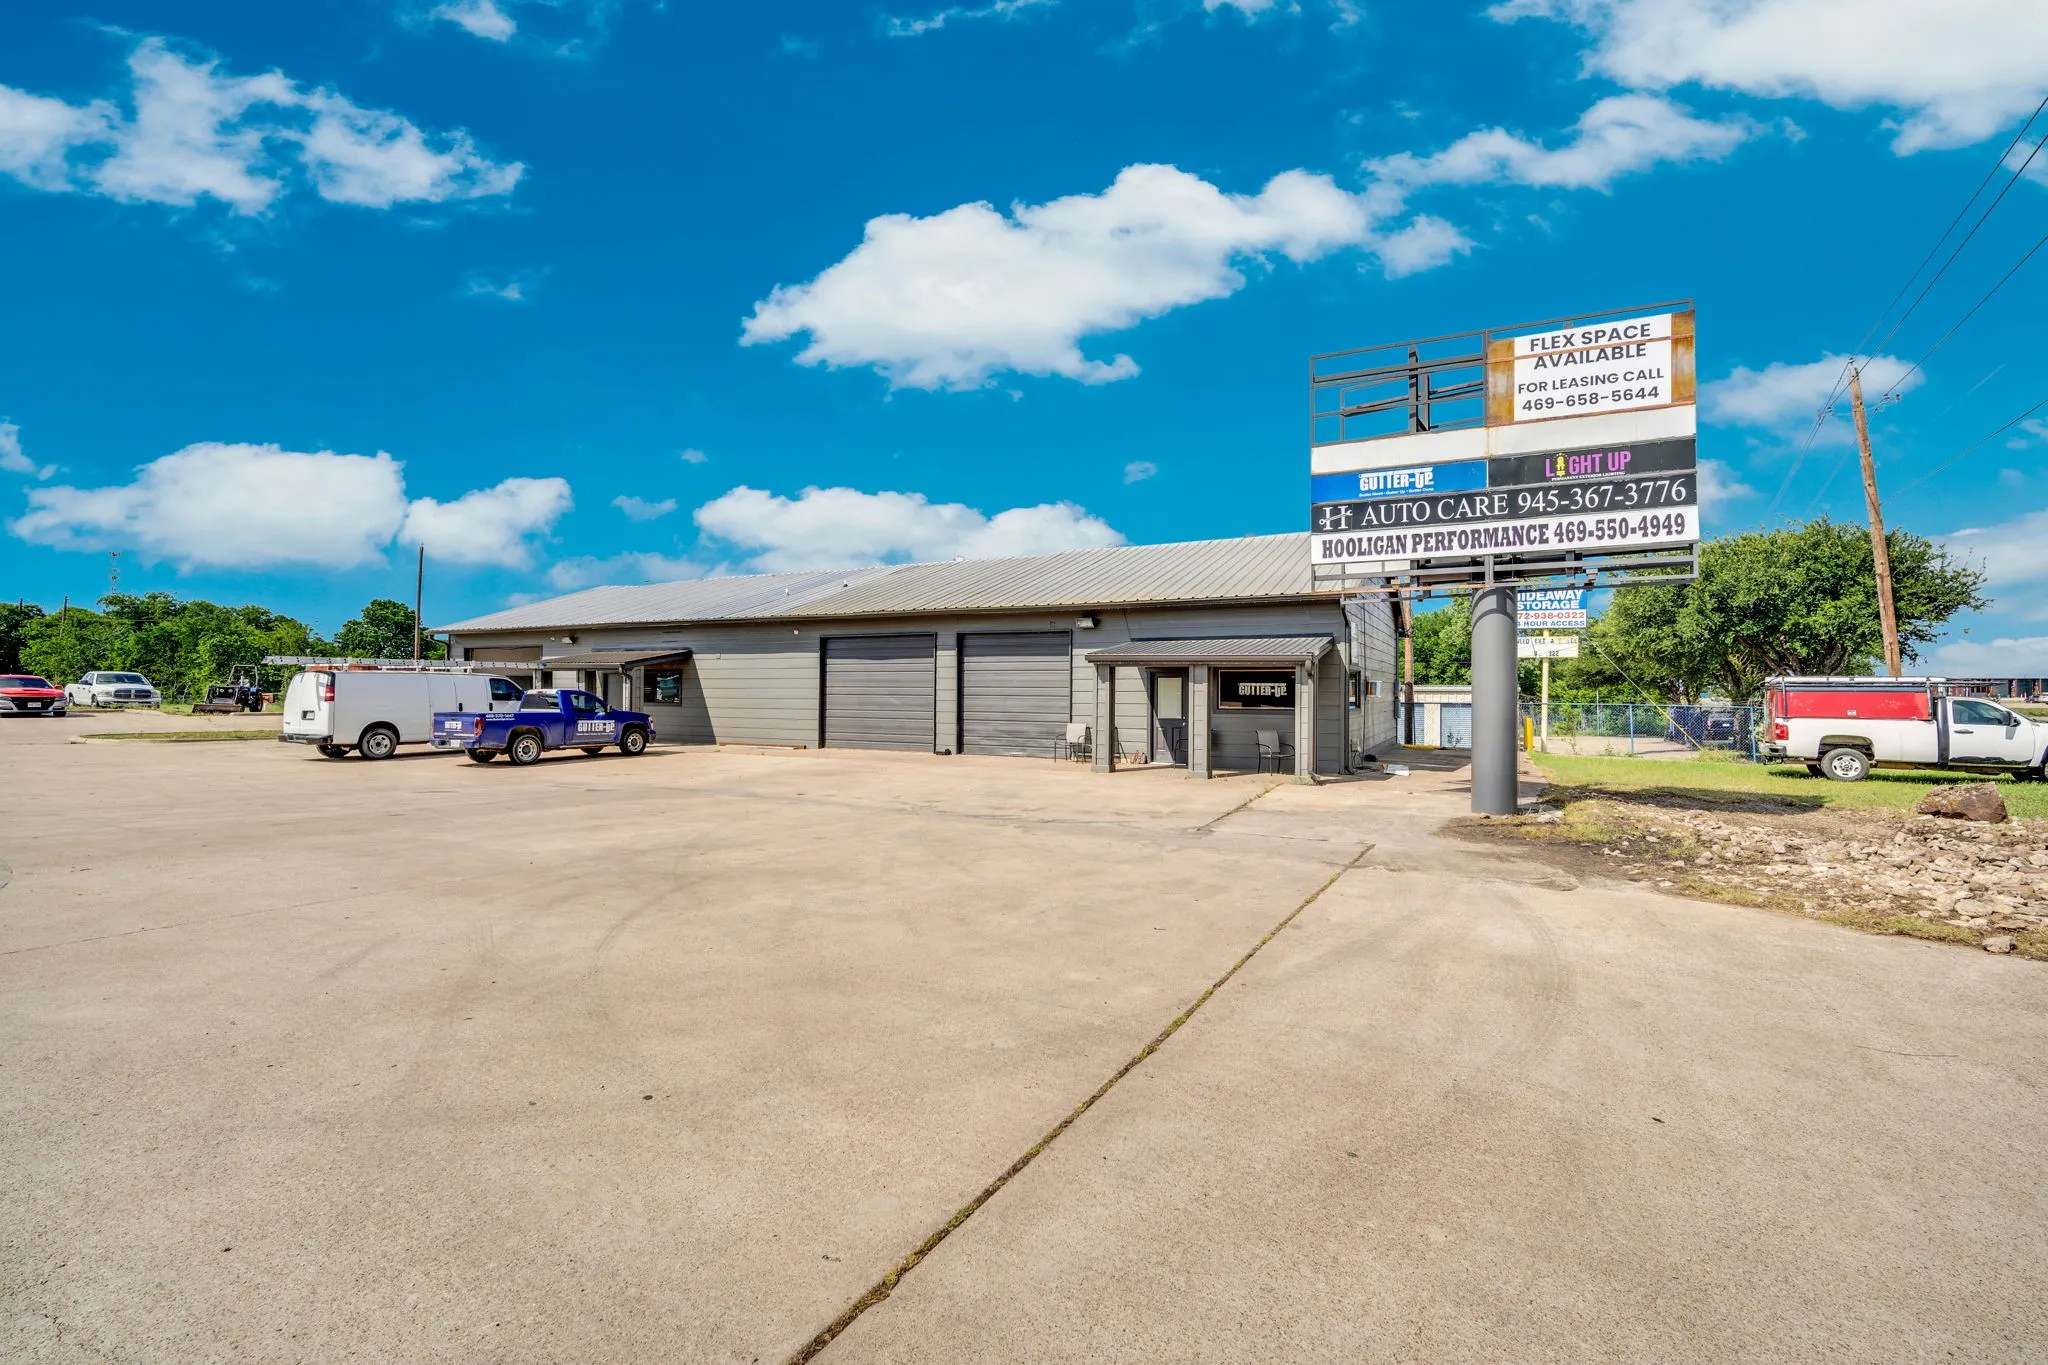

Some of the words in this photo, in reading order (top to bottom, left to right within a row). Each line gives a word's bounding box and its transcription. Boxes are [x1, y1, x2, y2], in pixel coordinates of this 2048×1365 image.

[1530, 333, 1575, 352] FLEX
[1581, 322, 1651, 345] SPACE
[1533, 342, 1646, 370] AVAILABLE
[1518, 380, 1548, 394] FOR
[1552, 373, 1619, 391] LEASING
[1623, 367, 1665, 382] CALL
[1522, 386, 1660, 412] 469-658-5644
[1607, 450, 1631, 471] UP
[1361, 501, 1431, 526] AUTO
[1437, 493, 1509, 522] CARE
[1518, 478, 1686, 514] 945-367-3776
[1322, 533, 1408, 559] HOOLIGAN
[1411, 523, 1549, 554] PERFORMANCE
[1554, 512, 1686, 543] 469-550-4949
[1517, 600, 1579, 609] STORAGE
